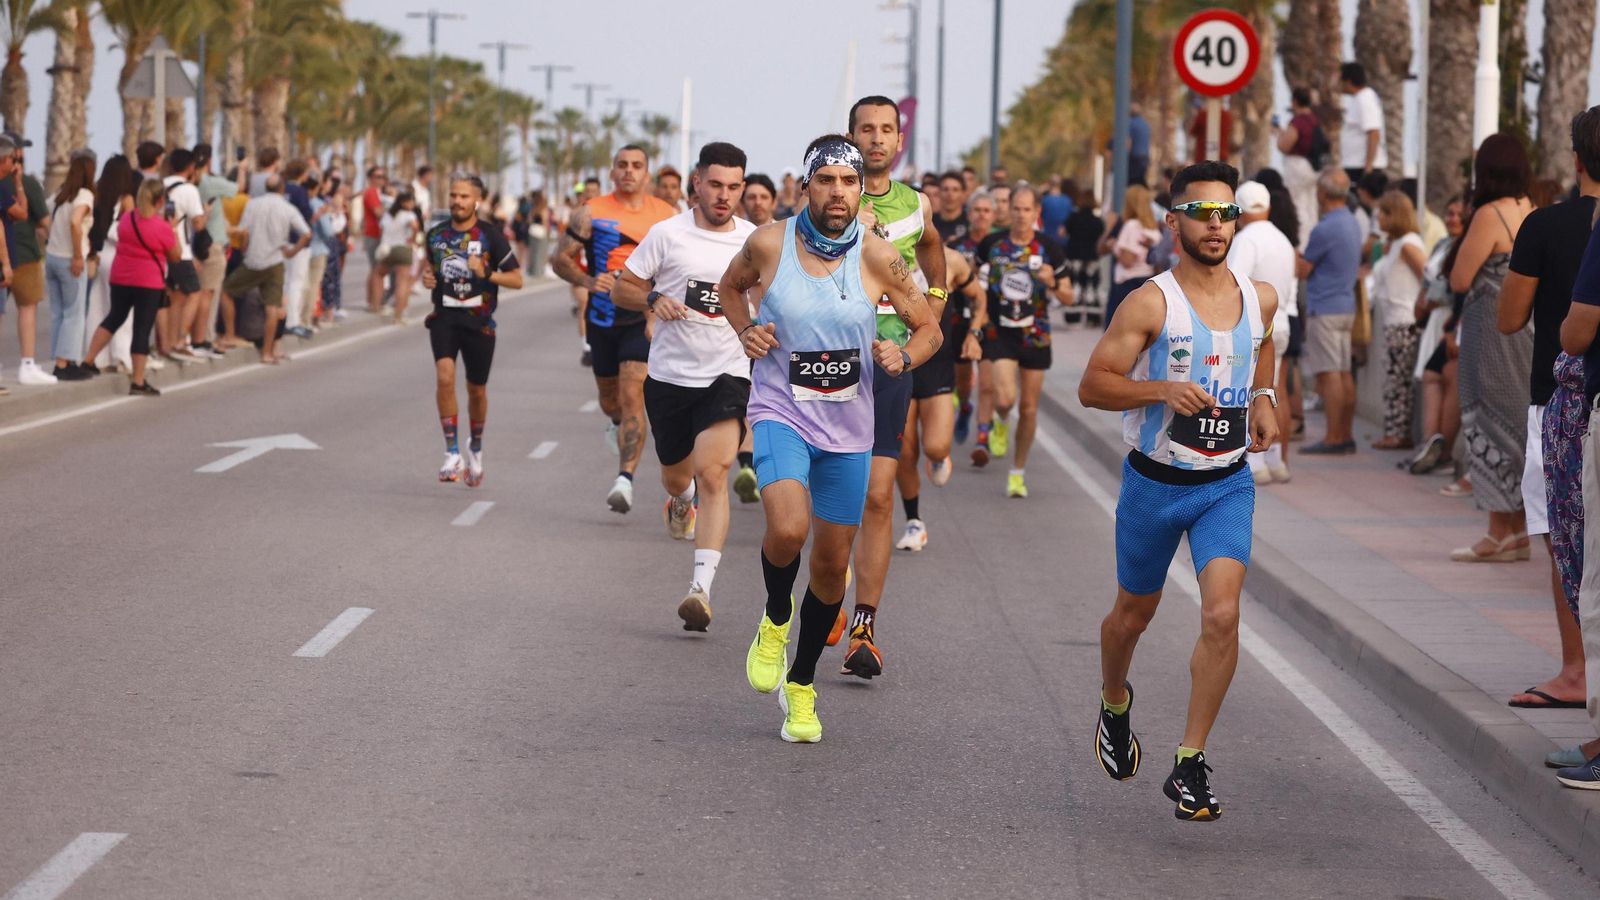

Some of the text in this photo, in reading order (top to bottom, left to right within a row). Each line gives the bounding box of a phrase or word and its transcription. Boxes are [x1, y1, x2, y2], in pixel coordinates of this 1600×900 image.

[1192, 36, 1236, 67] 40
[1169, 335, 1193, 344] vive
[799, 361, 852, 375] 2069
[1198, 417, 1230, 435] 118
